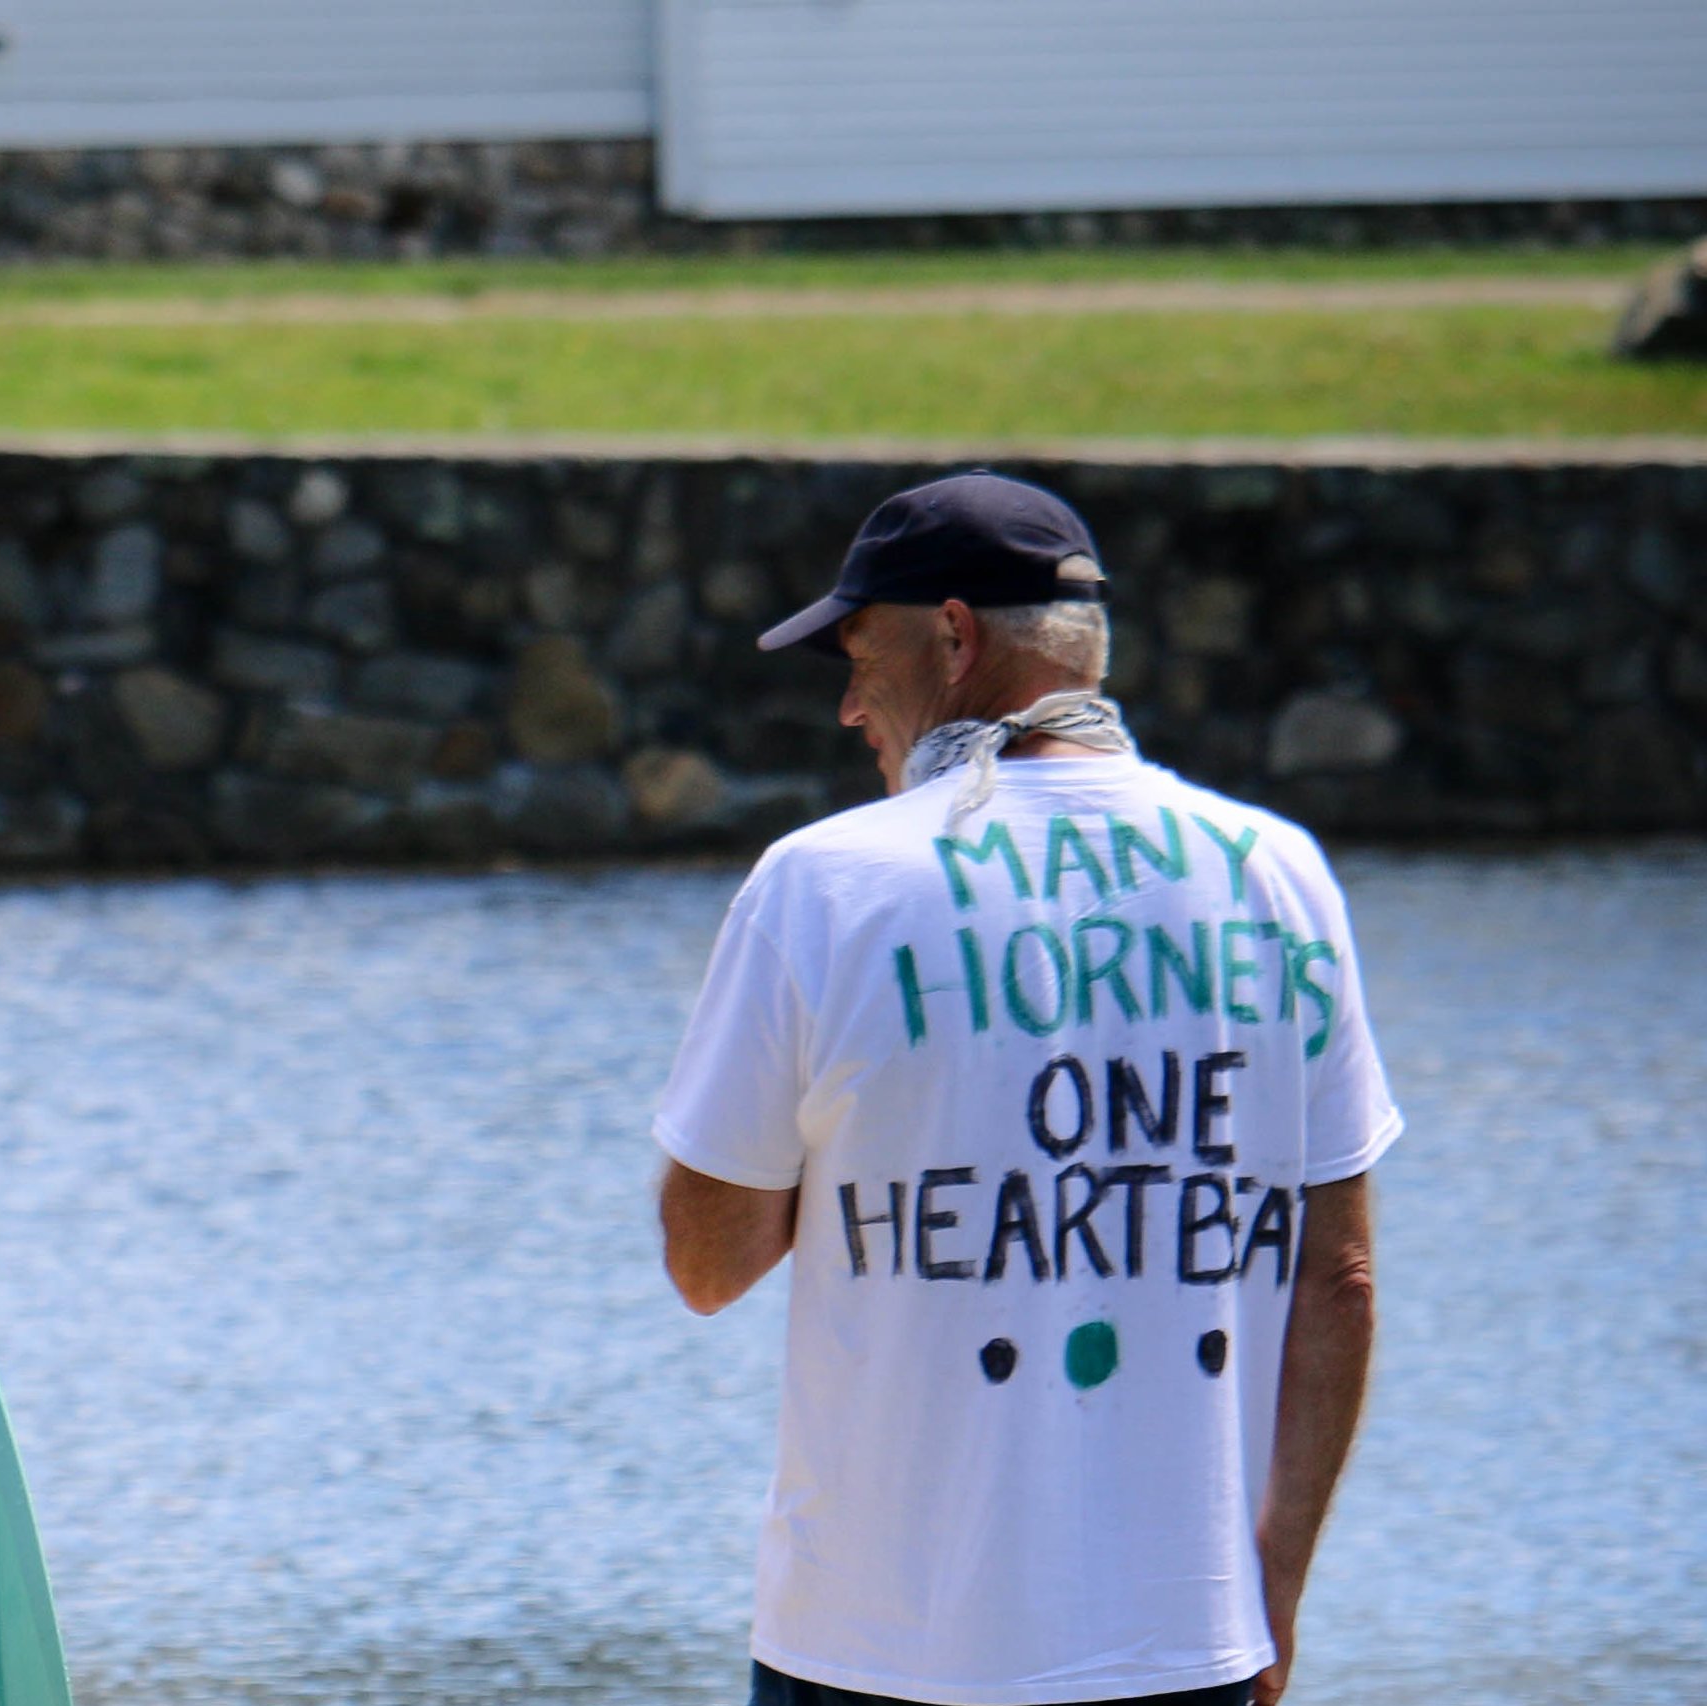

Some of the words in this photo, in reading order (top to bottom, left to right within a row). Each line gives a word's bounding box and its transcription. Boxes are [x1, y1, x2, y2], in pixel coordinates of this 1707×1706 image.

[932, 805, 1260, 910] MANY
[892, 916, 1339, 1062] HORNETS
[1025, 1050, 1248, 1166] ONE
